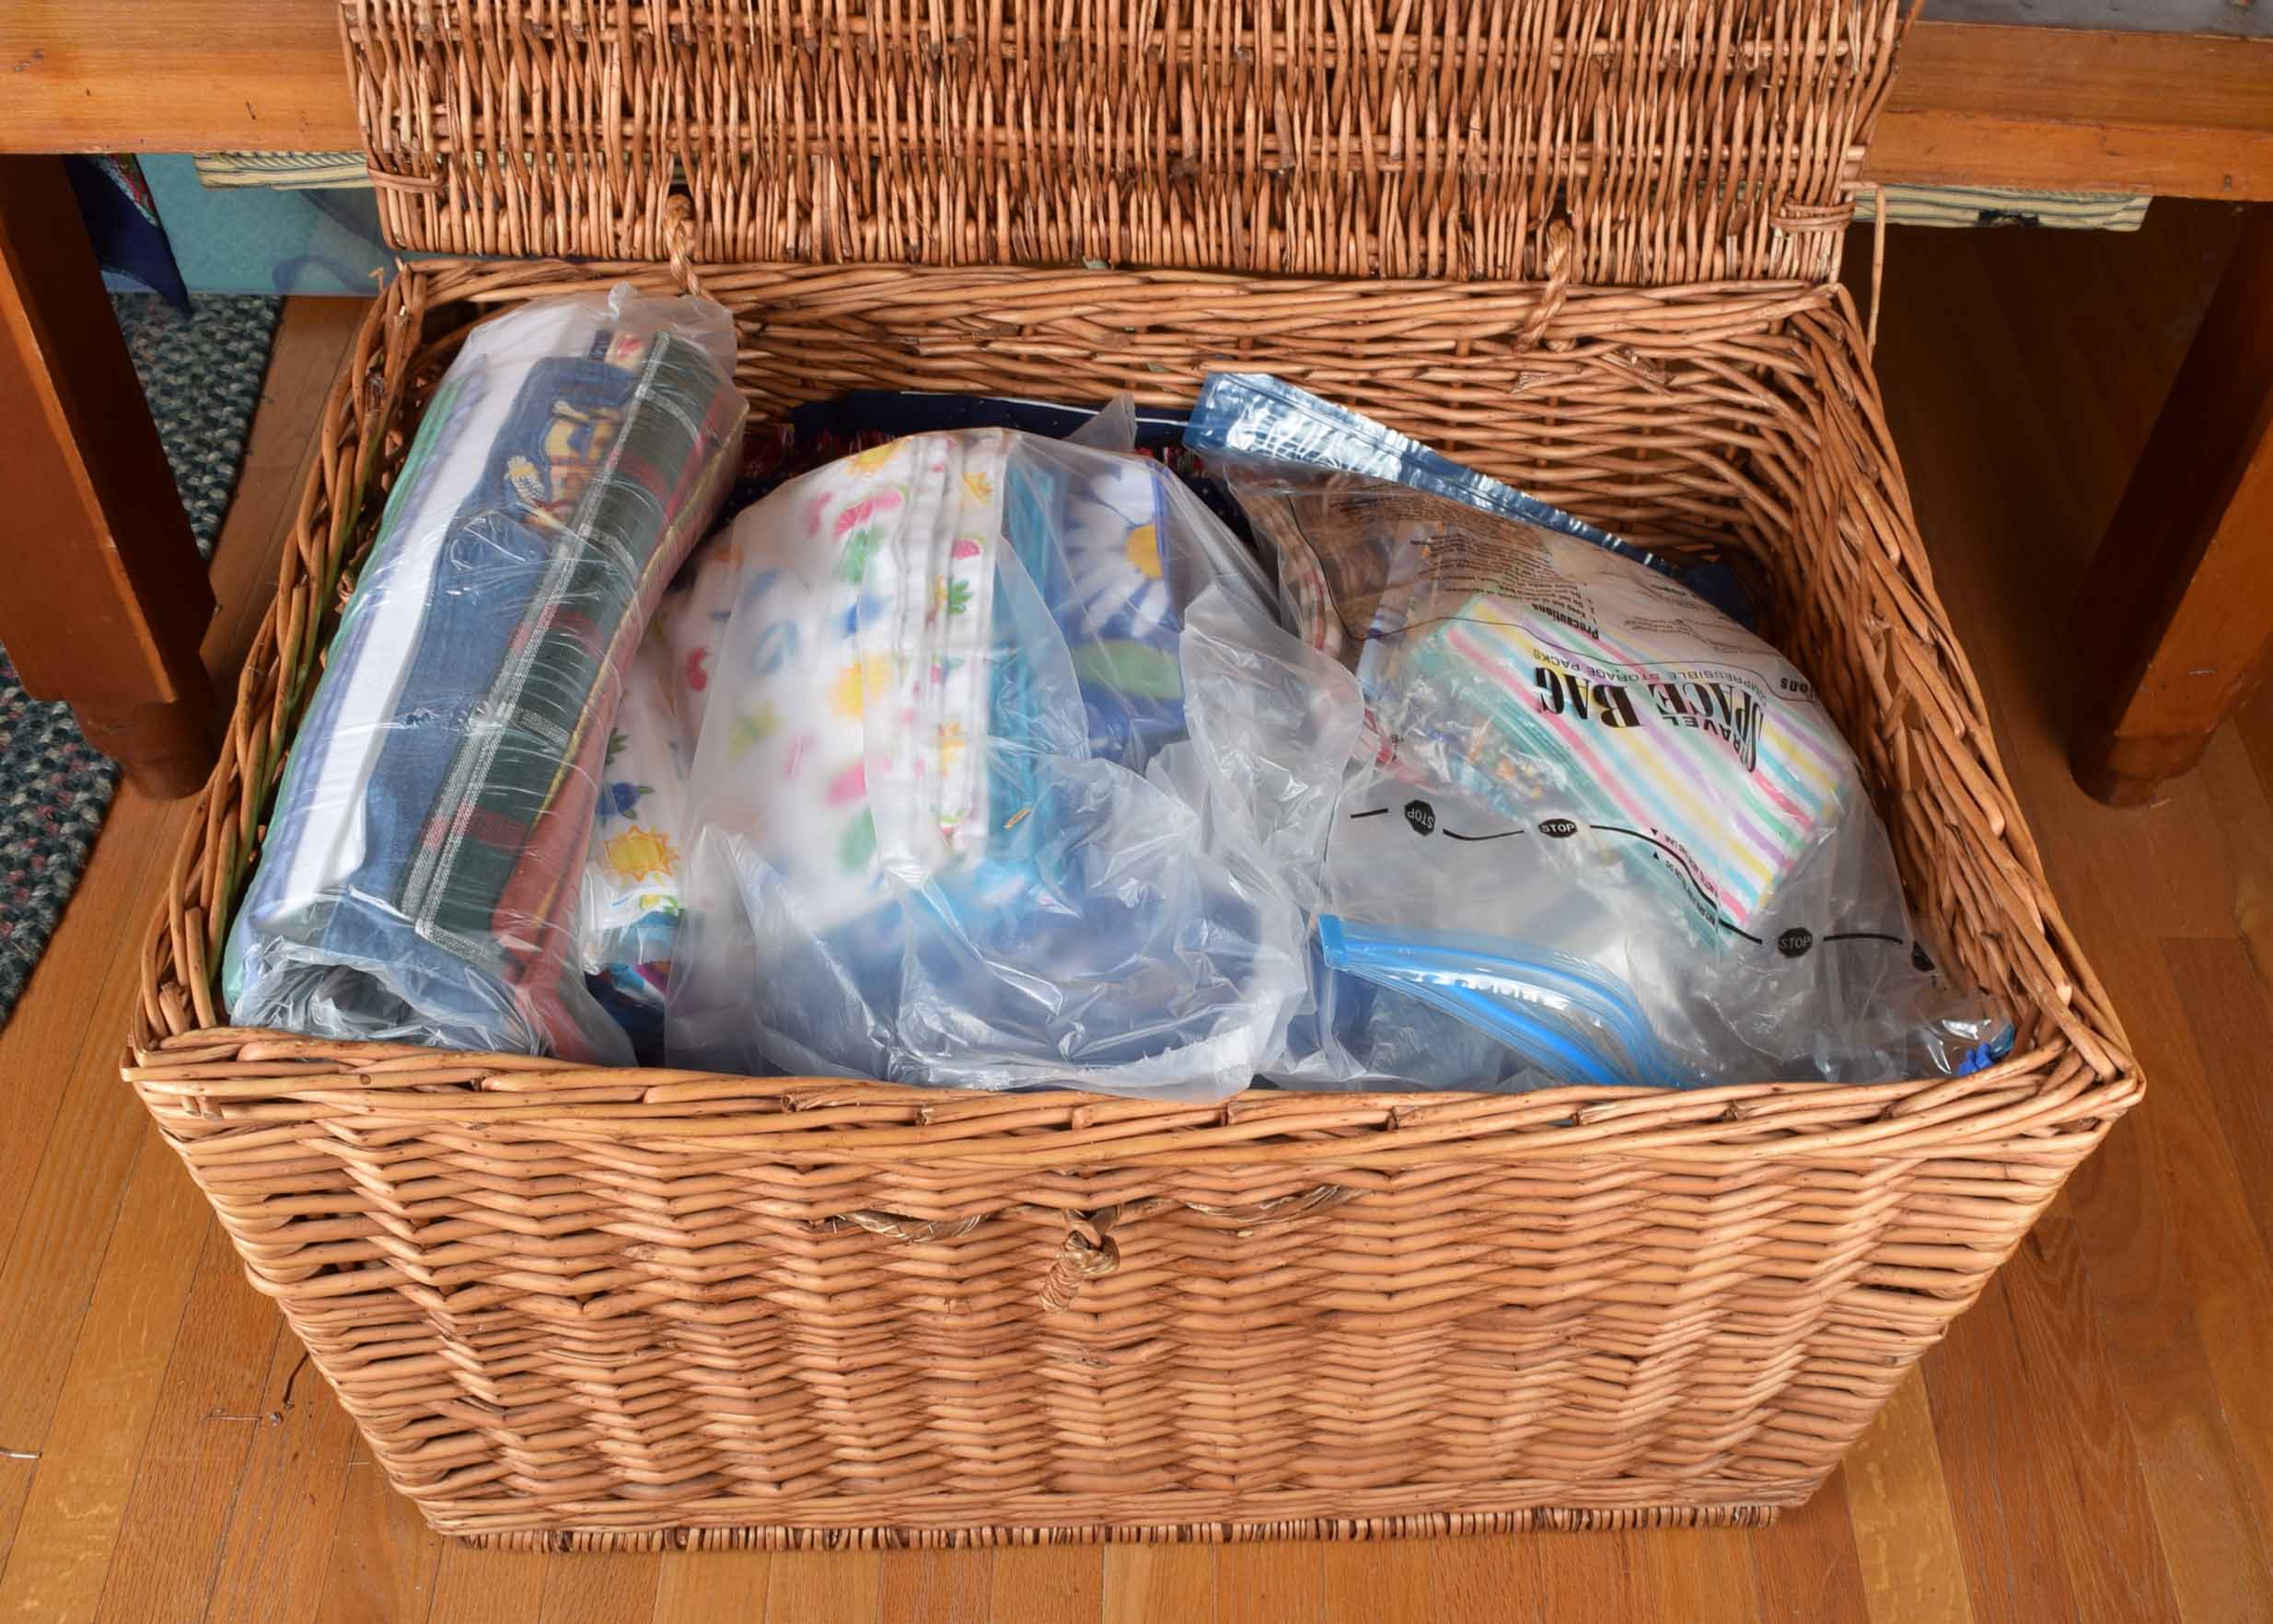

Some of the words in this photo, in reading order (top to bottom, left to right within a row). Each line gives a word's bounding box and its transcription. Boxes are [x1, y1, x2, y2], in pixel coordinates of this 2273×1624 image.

[1531, 603, 1600, 641] Precautions
[1531, 647, 1582, 672] PACKS
[1583, 667, 1661, 683] STORAGE
[1534, 666, 1645, 729] BAG
[1664, 669, 1768, 708] COMPRESSIBLE
[1648, 681, 1765, 773] SPACE
[1407, 807, 1435, 829] STOP
[1541, 822, 1576, 834] STOP
[1779, 935, 1814, 950] STOP
